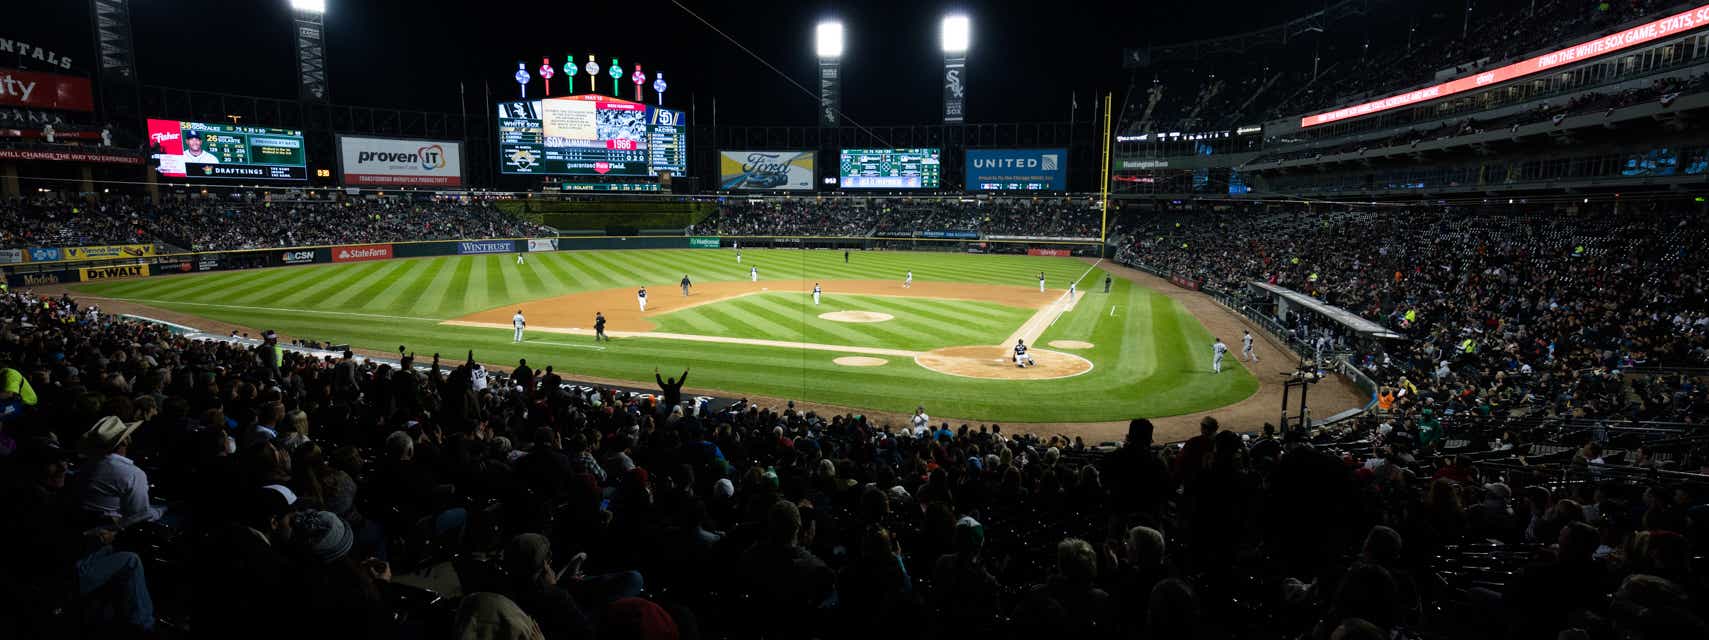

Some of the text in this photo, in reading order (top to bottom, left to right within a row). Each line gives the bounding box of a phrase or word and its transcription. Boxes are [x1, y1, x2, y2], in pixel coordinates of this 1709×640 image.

[1539, 55, 1558, 68] FIND
[1559, 50, 1575, 63] THE
[1576, 43, 1604, 58] WHITE
[1605, 35, 1624, 49] SOX
[1626, 25, 1657, 43] GAME,
[1659, 13, 1693, 34] STATS,
[547, 137, 563, 147] SOX
[21, 152, 54, 160] CHANGE
[358, 151, 438, 164] proven IT
[742, 153, 792, 175] Ford
[974, 159, 1037, 168] UNITED
[1123, 160, 1154, 169] Huntington
[294, 251, 314, 260] CSN
[473, 369, 485, 380] 12
